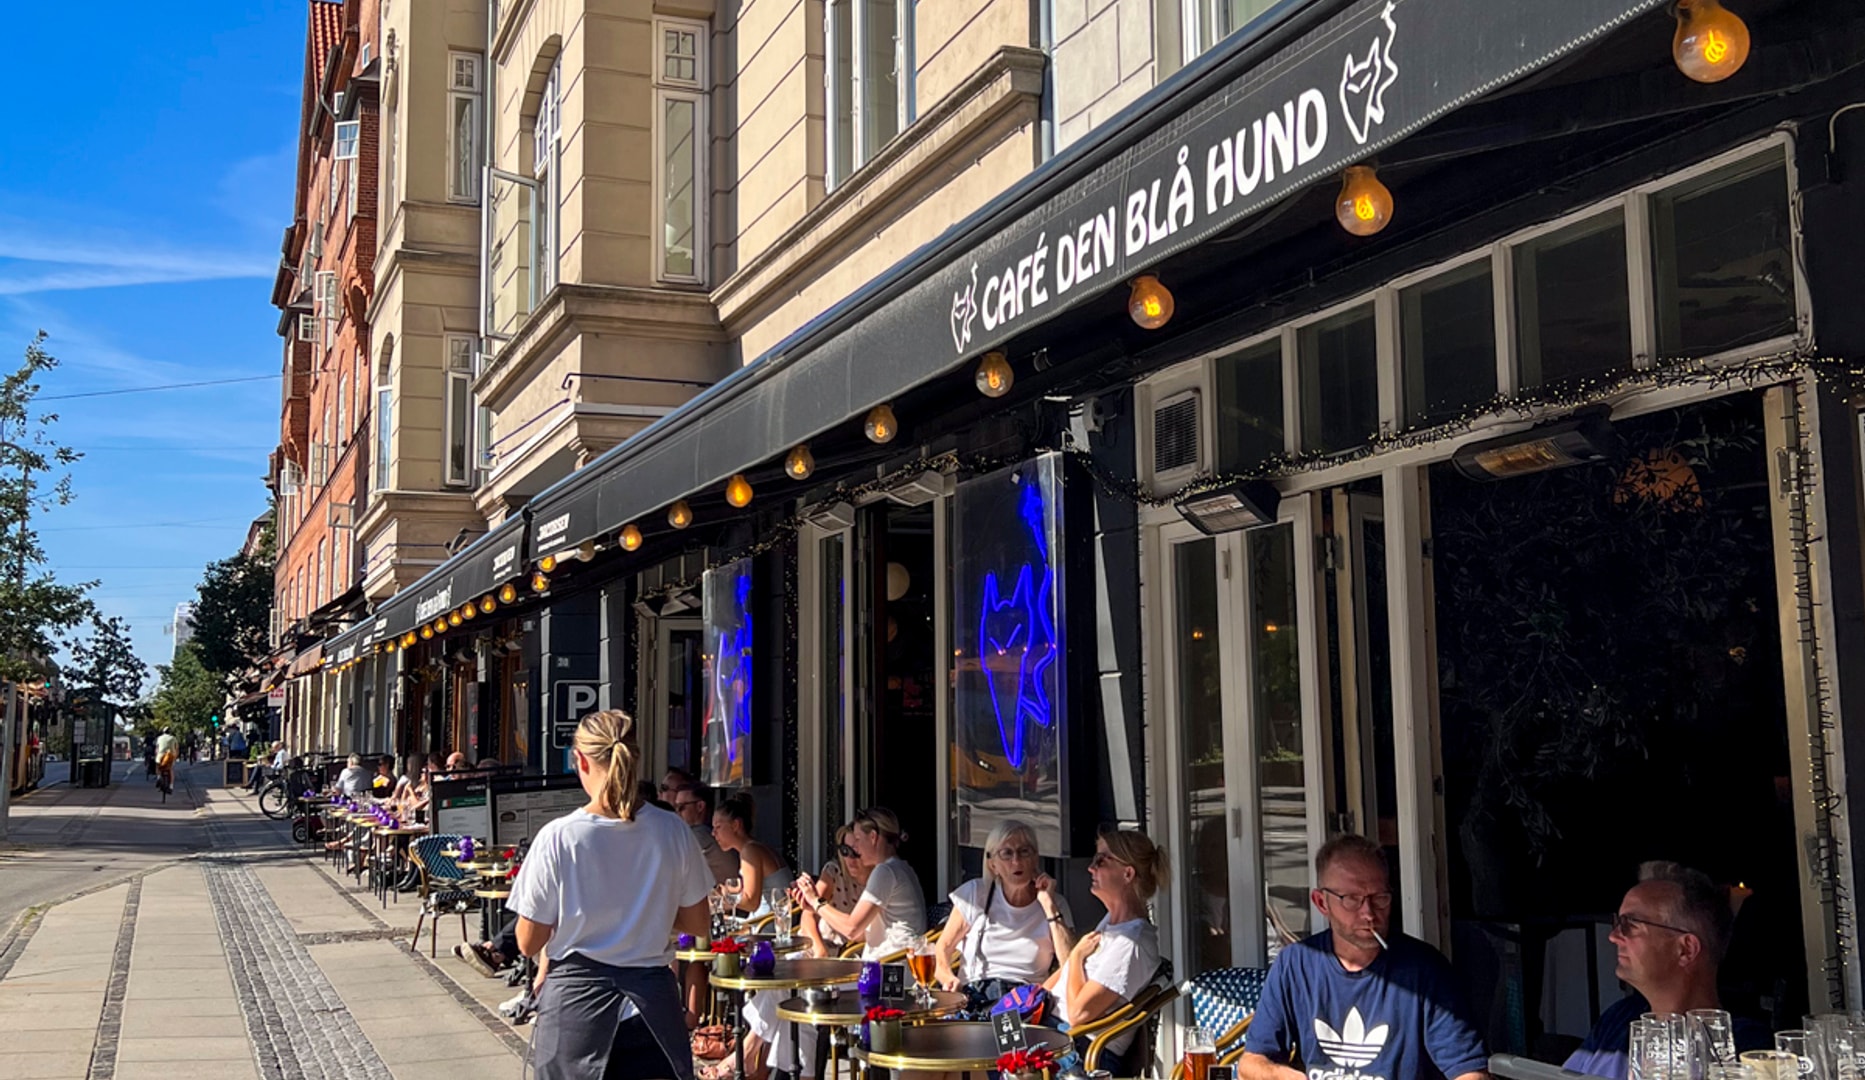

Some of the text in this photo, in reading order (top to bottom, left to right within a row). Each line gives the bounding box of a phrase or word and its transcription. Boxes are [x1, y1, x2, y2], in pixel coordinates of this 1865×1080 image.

[982, 88, 1328, 331] CAFÉ DEN BLÅ HUND
[567, 685, 597, 720] P
